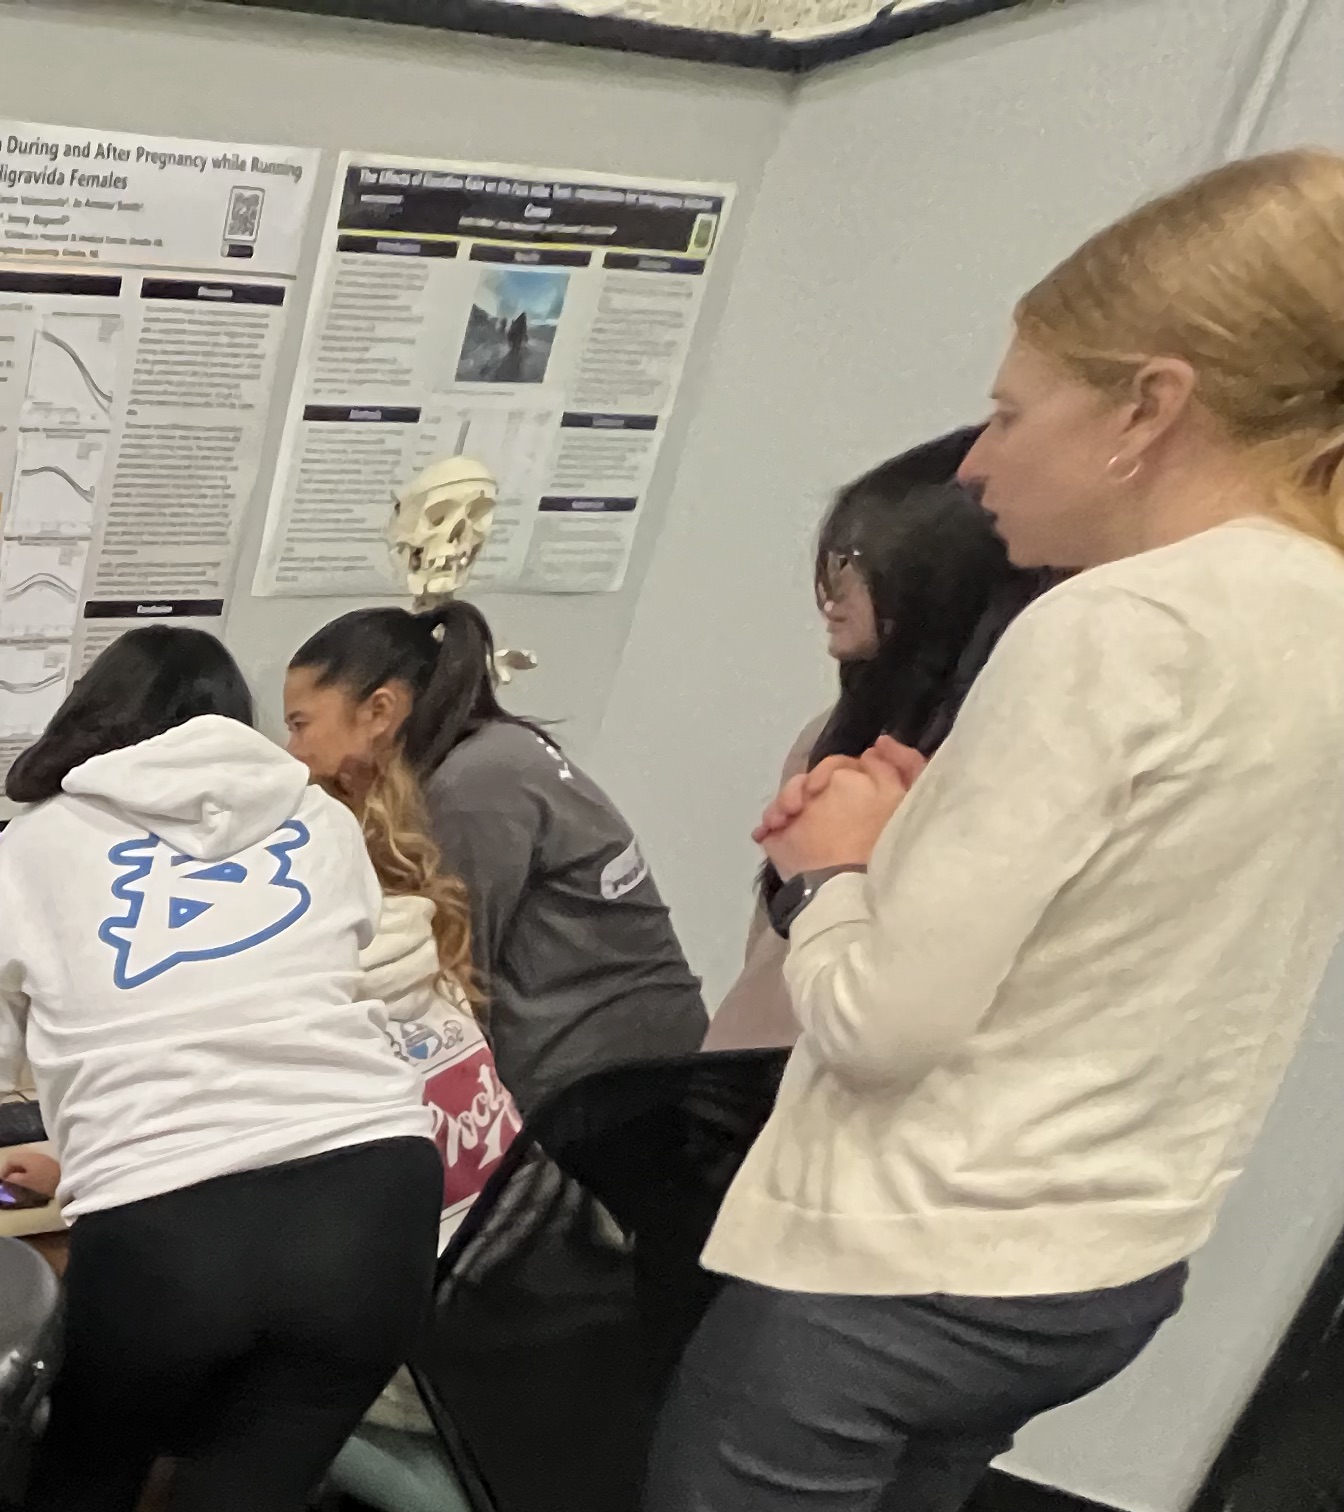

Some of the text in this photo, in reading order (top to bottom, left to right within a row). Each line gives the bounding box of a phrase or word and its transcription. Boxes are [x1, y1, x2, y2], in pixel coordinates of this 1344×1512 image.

[7, 134, 59, 161] During
[63, 139, 92, 158] and
[96, 140, 131, 163] After
[135, 145, 208, 173] Pregnancy
[212, 152, 247, 174] while
[251, 156, 304, 184] Running
[69, 168, 128, 191] Females
